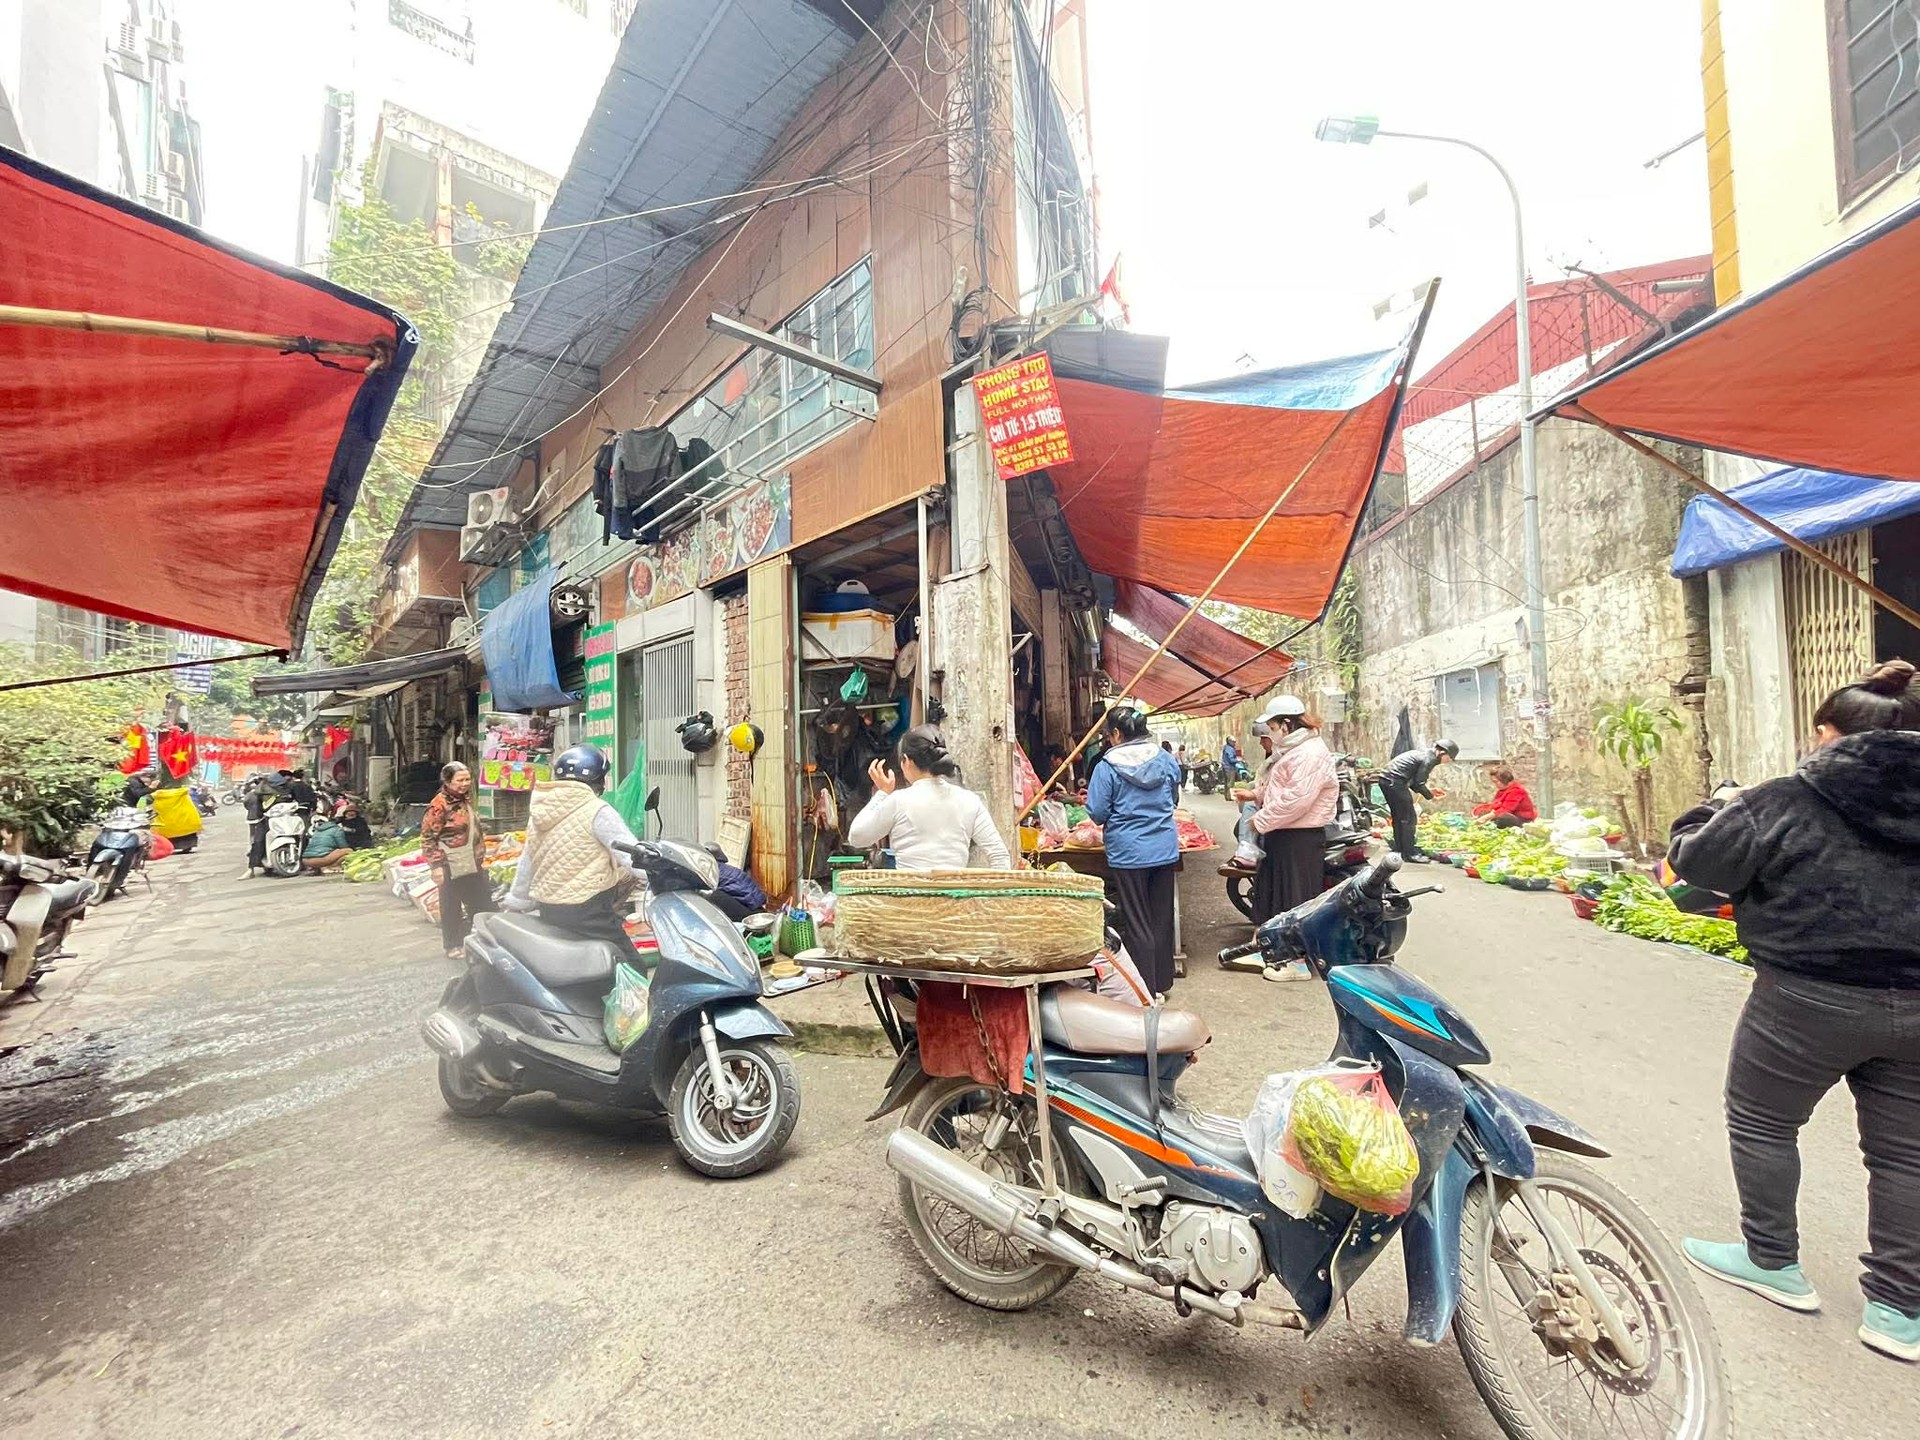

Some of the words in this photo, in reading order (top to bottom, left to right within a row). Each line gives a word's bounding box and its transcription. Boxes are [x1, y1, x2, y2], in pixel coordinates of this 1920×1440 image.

[983, 385, 1019, 408] HOME
[1021, 376, 1050, 394] STAY
[987, 406, 1010, 420] FULL
[1021, 413, 1036, 433] 1.5
